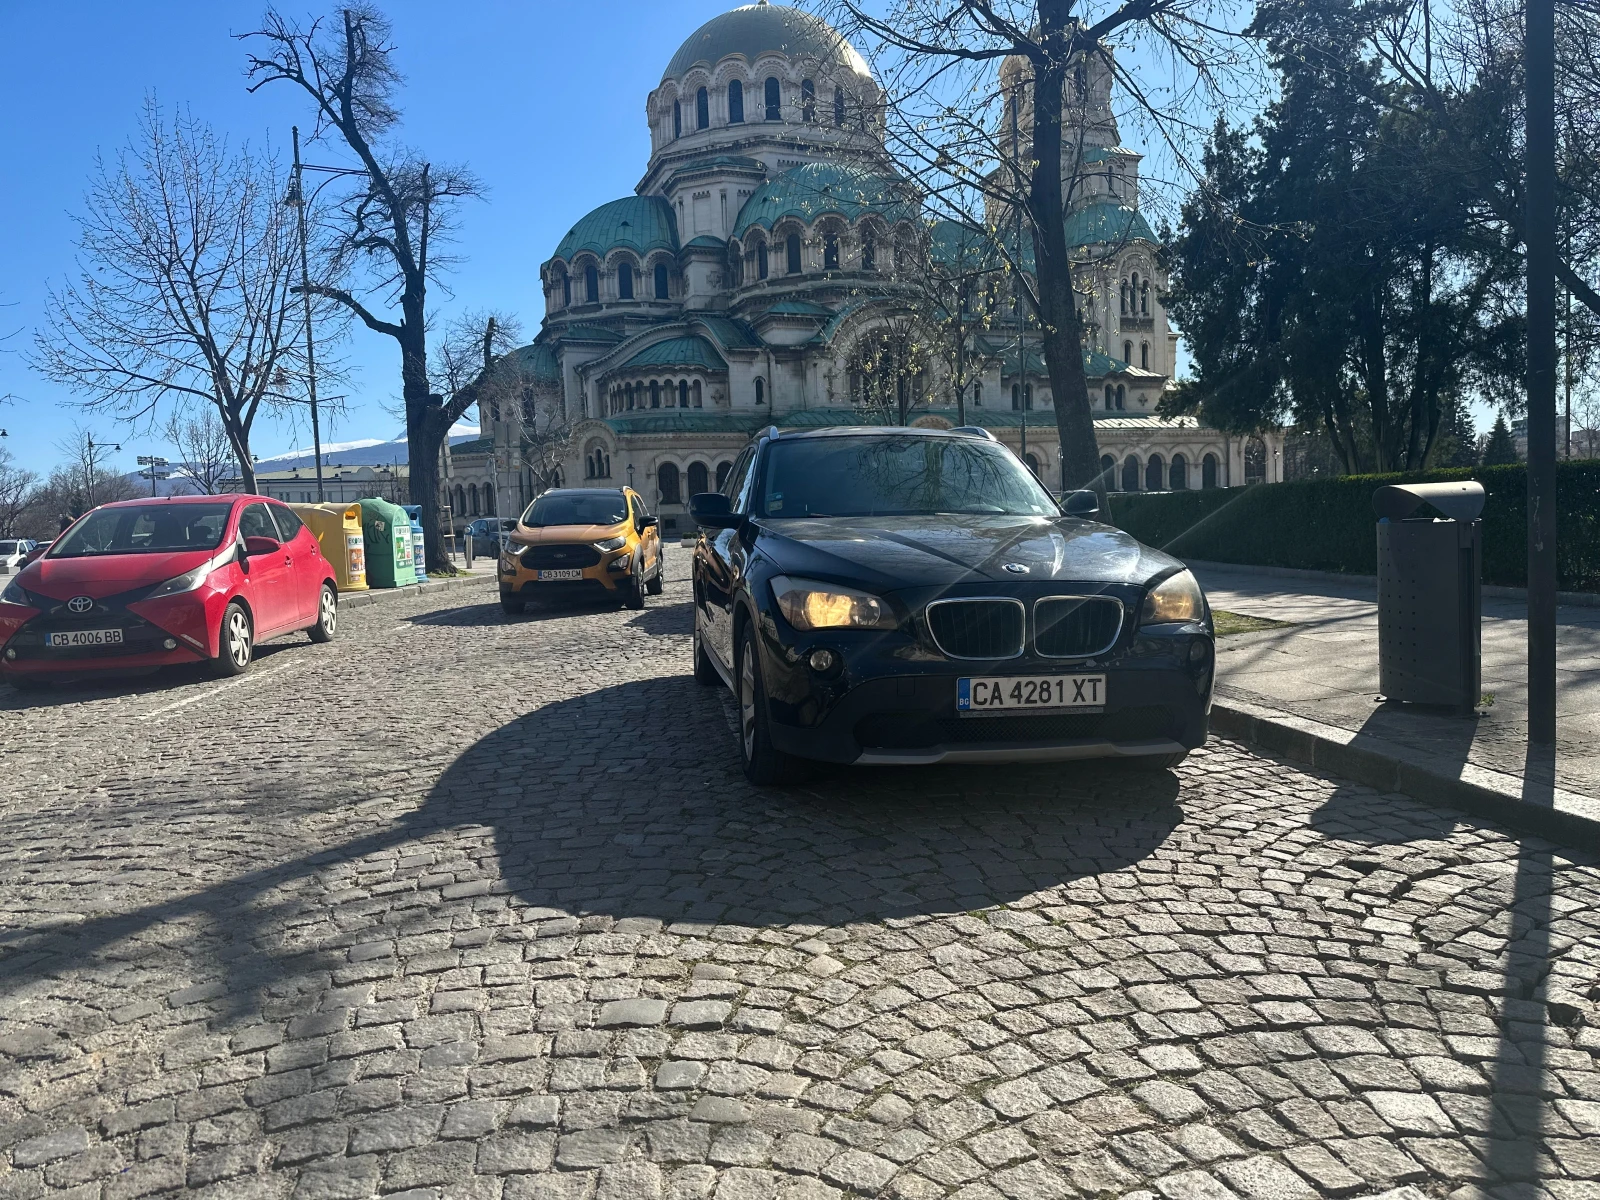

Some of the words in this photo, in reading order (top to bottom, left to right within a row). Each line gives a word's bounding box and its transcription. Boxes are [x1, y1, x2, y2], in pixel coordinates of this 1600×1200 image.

[543, 570, 552, 579] CB
[553, 570, 570, 578] 3109
[53, 634, 69, 646] CB
[72, 632, 102, 644] 4006
[104, 631, 121, 643] BB
[973, 681, 1003, 706] CA
[1009, 679, 1064, 704] 4281
[1072, 678, 1102, 703] XT
[959, 698, 969, 706] BG
